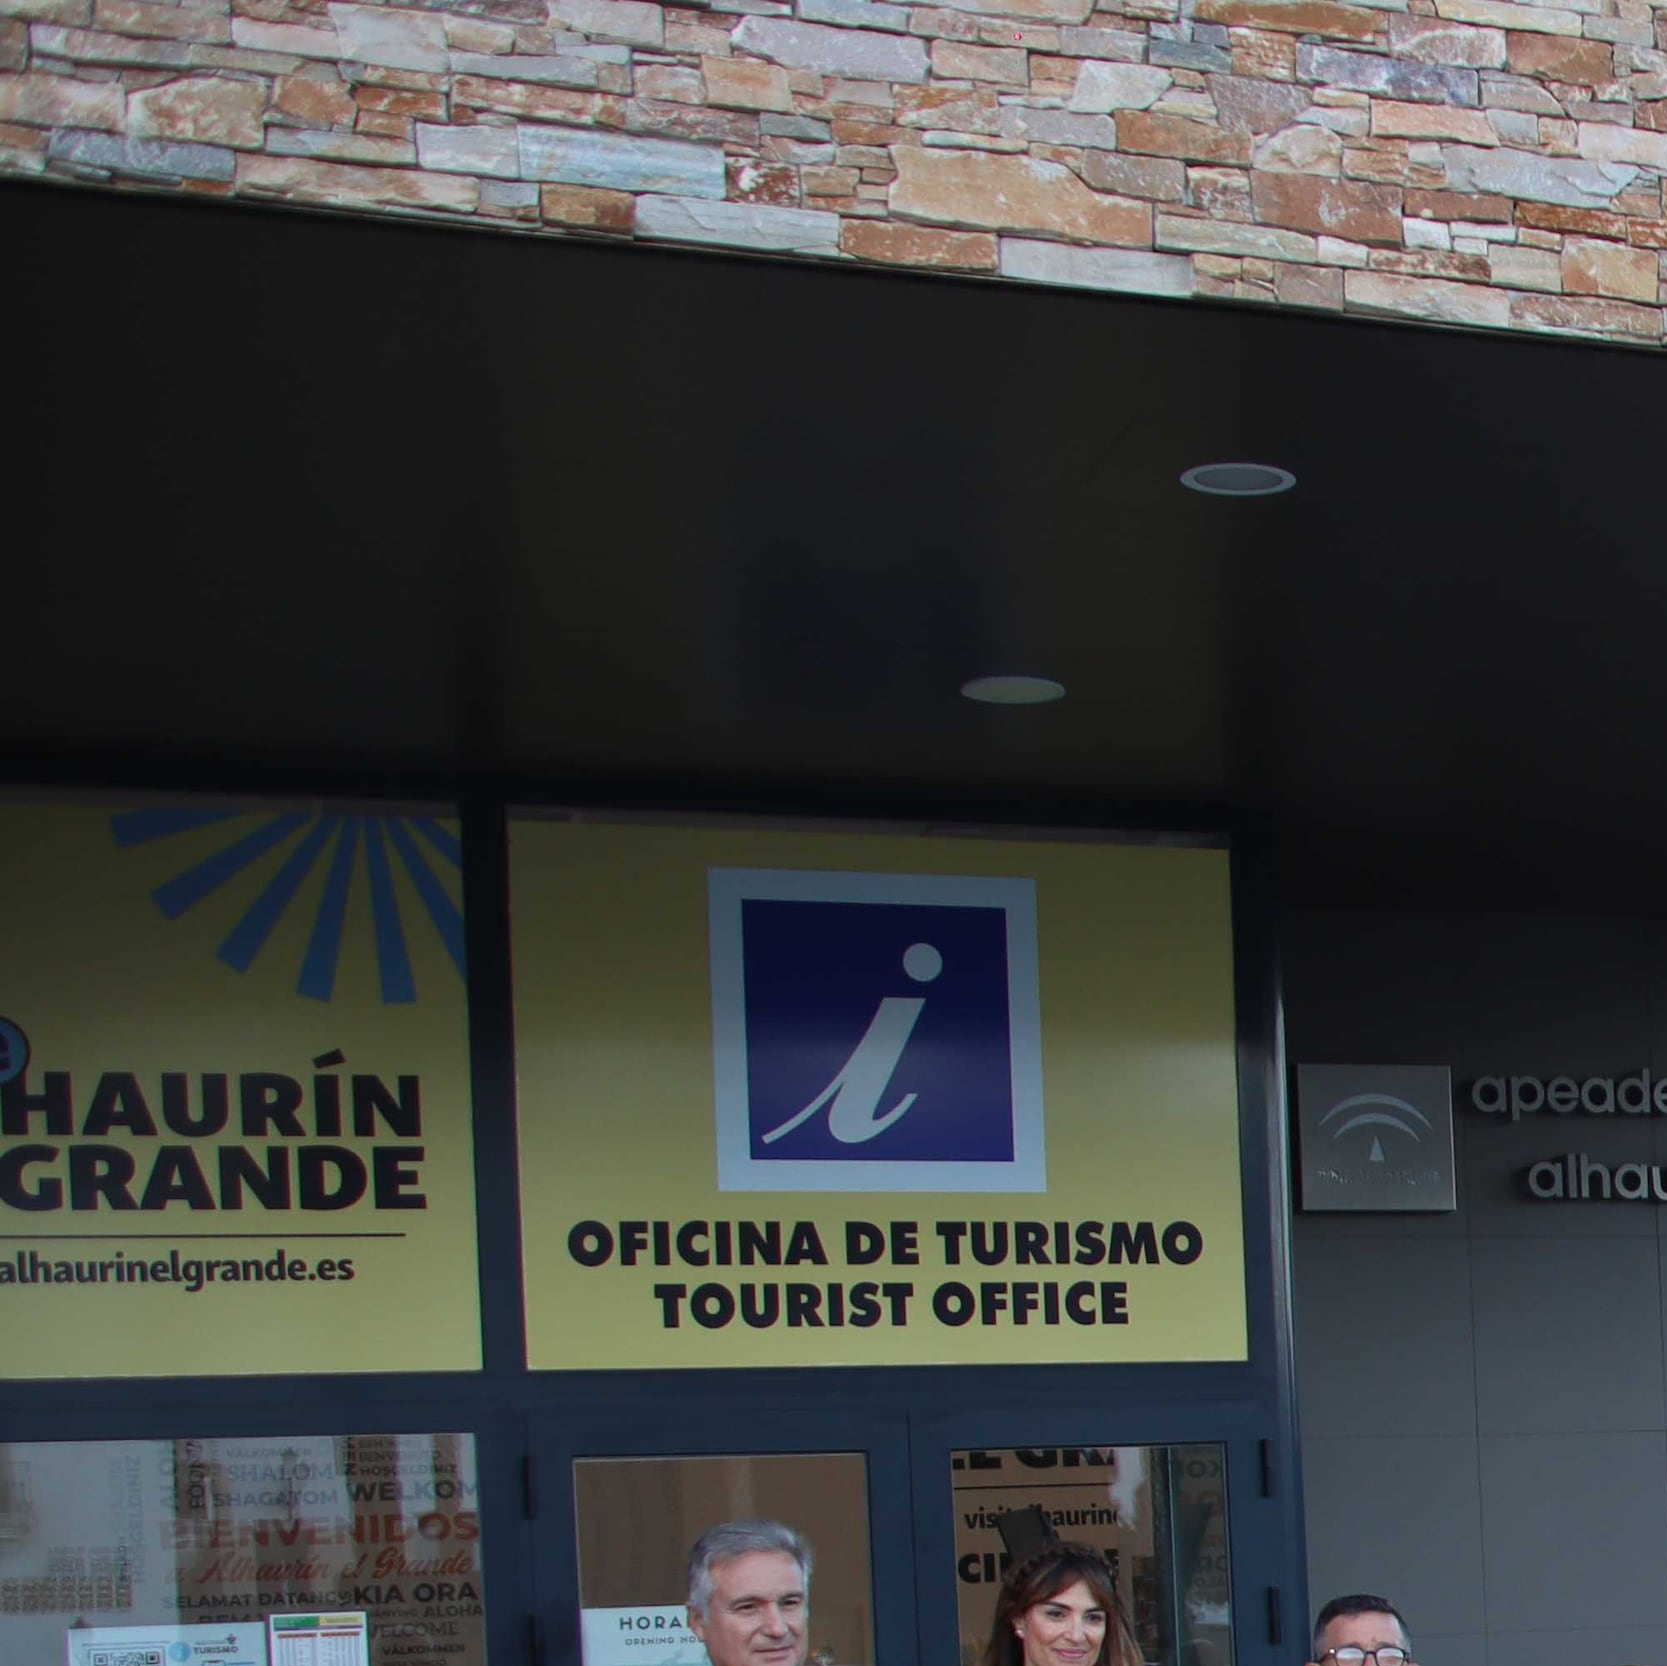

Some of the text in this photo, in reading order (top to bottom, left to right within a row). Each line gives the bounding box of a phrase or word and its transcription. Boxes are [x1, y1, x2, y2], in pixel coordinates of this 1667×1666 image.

[0, 1144, 428, 1212] GRANDE
[568, 1220, 1204, 1266] OFICINA DE TURISMO
[653, 1281, 1129, 1329] TOURIST OFFICE
[161, 1512, 480, 1549] BIENVENIDOS
[353, 1584, 405, 1604] KIA
[414, 1582, 479, 1602] ORA
[423, 1605, 484, 1618] ALOHA
[620, 1615, 690, 1631] HORA
[193, 1645, 239, 1655] TURISMO
[625, 1637, 675, 1646] OPENING
